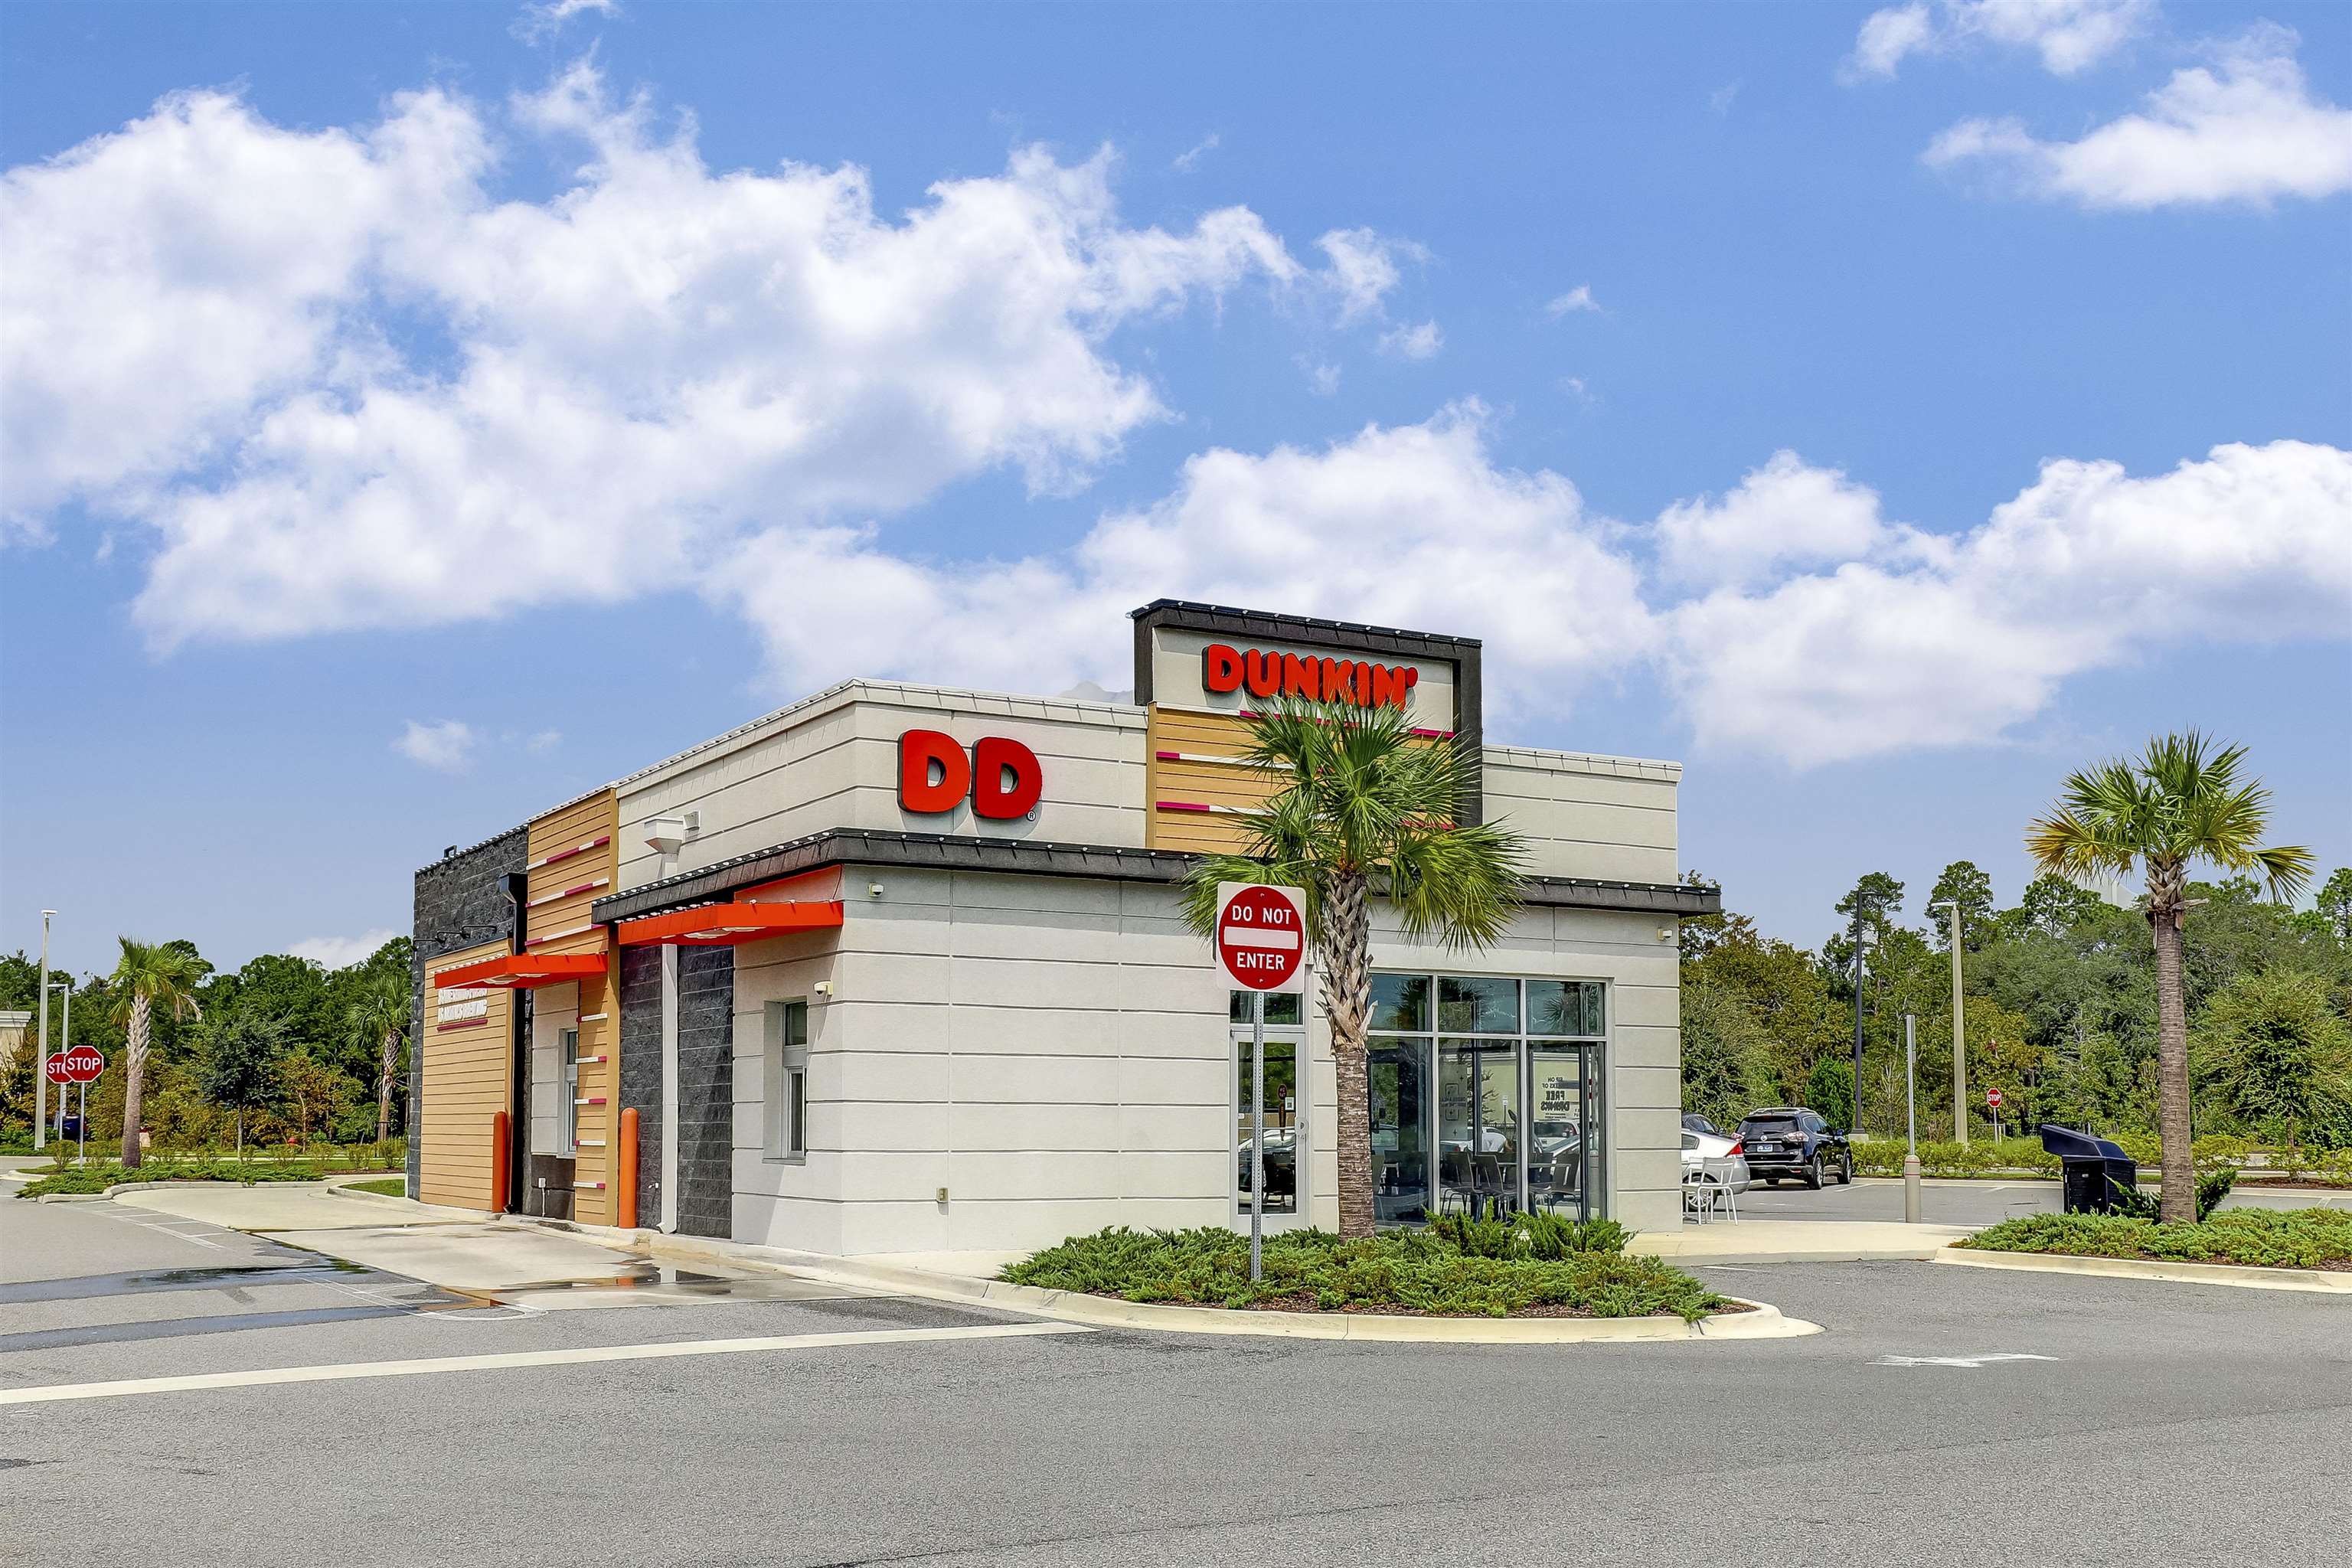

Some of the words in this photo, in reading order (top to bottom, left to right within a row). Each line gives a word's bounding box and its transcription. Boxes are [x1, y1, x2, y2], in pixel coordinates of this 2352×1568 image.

[1202, 643, 1419, 711] DUNKIN'
[897, 729, 1042, 820] DD
[1232, 905, 1253, 922] DO
[1263, 907, 1292, 925] NOT
[1236, 952, 1285, 971] ENTER
[47, 1062, 65, 1073] ST
[67, 1057, 100, 1070] STOP
[1988, 1093, 2001, 1102] STOP
